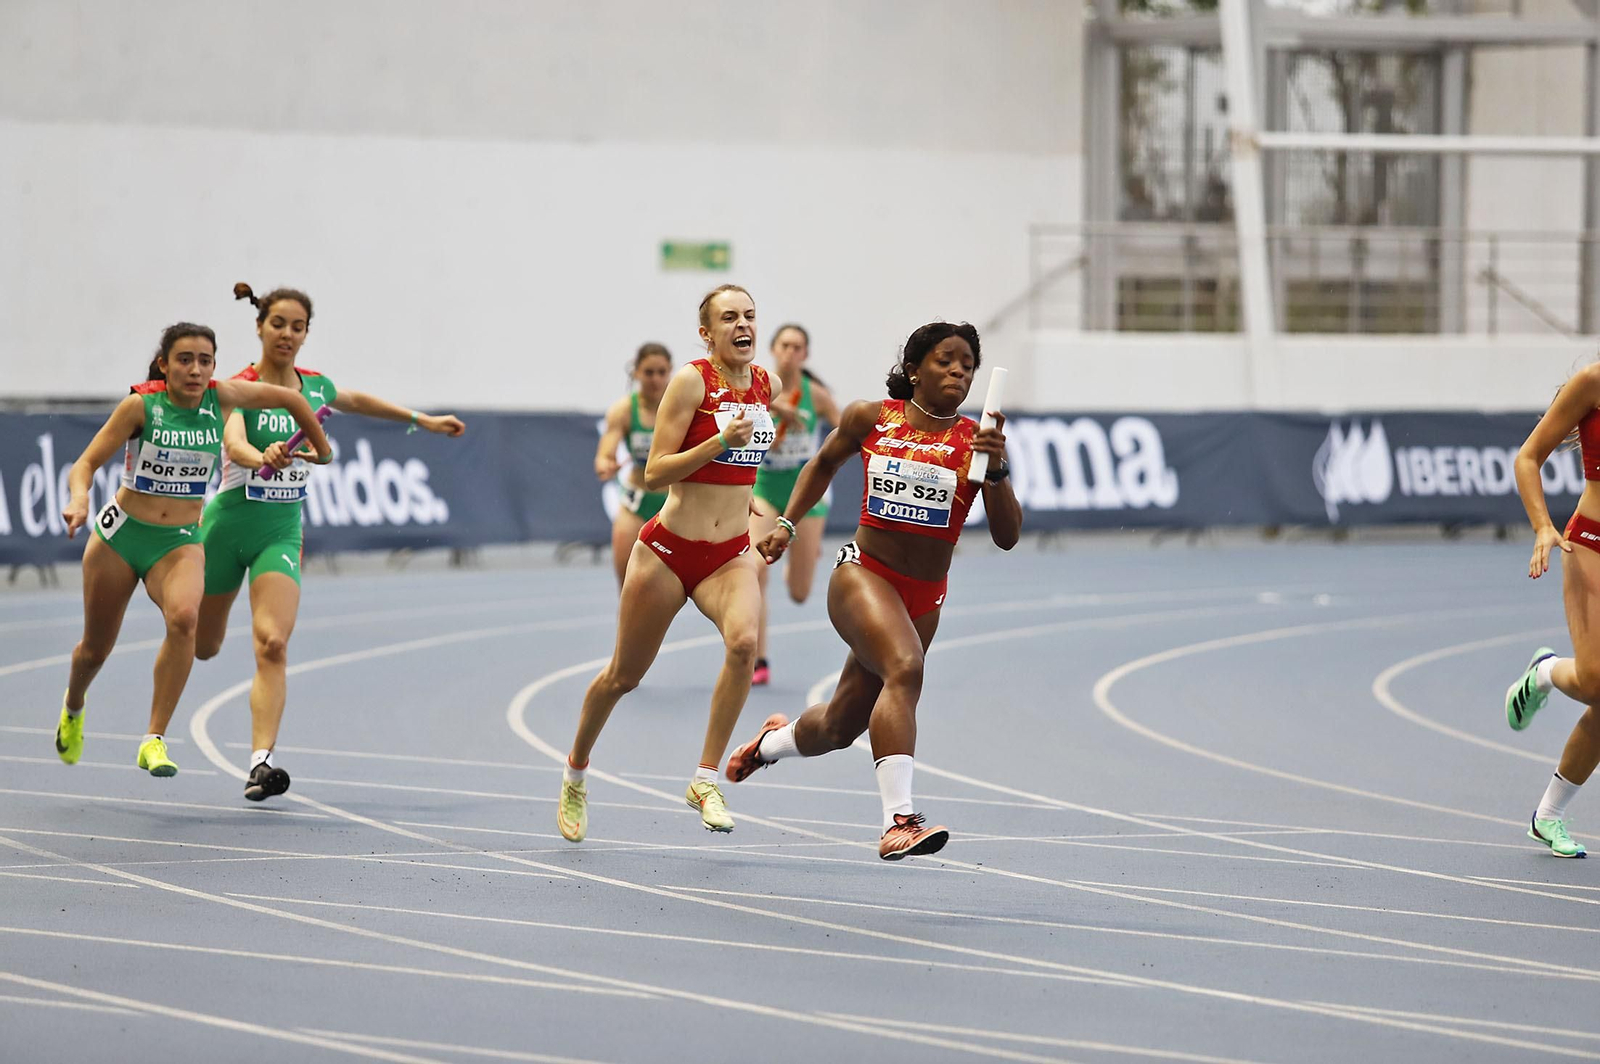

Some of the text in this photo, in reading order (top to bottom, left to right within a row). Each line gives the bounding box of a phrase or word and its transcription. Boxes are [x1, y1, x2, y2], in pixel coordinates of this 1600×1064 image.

[151, 427, 220, 446] PORTUGAL
[753, 431, 774, 444] S23
[874, 436, 956, 455] ESPAÑA
[727, 450, 763, 463] Joma
[141, 460, 208, 477] POR S20
[251, 469, 284, 482] PR
[148, 478, 191, 494] Joma
[872, 476, 907, 495] ESP
[912, 484, 948, 503] S23
[101, 505, 119, 529] 6
[879, 500, 930, 522] Joma
